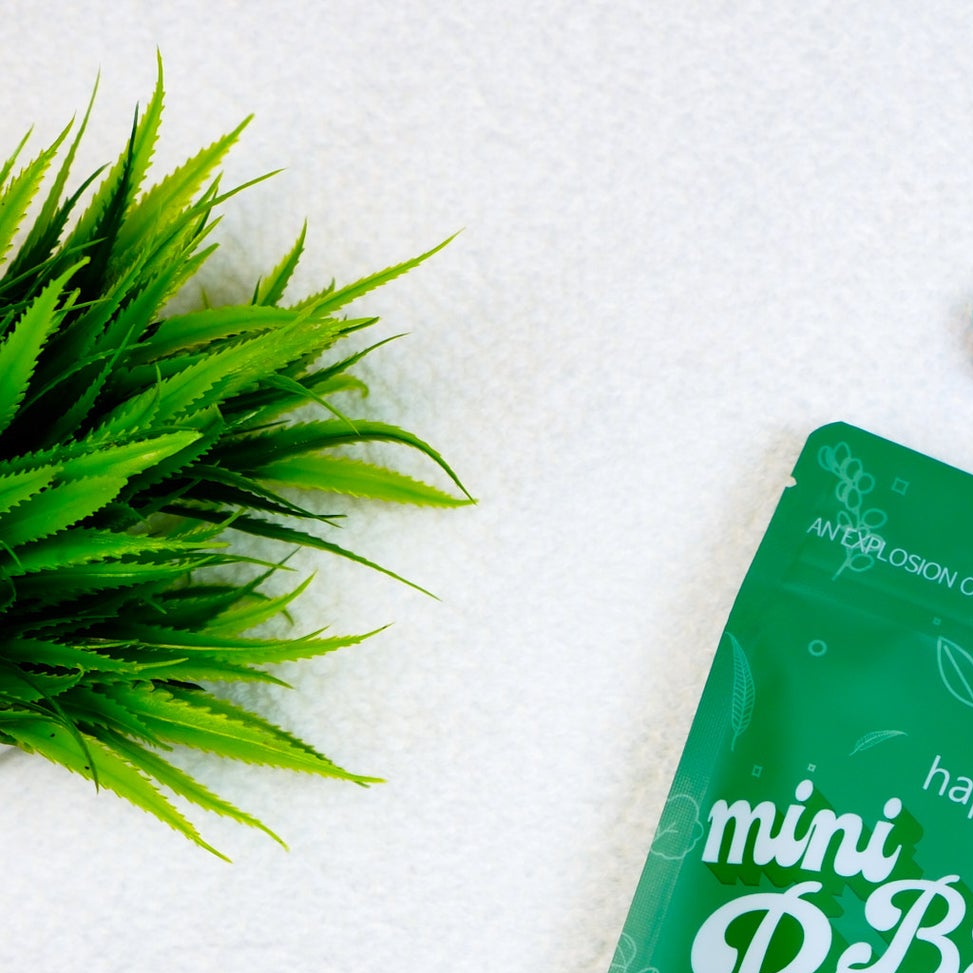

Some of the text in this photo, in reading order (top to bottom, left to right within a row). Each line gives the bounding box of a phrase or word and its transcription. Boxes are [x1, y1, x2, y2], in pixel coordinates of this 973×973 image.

[807, 517, 841, 541] AN
[841, 527, 958, 589] EXPLOSION
[701, 779, 901, 883] mini
